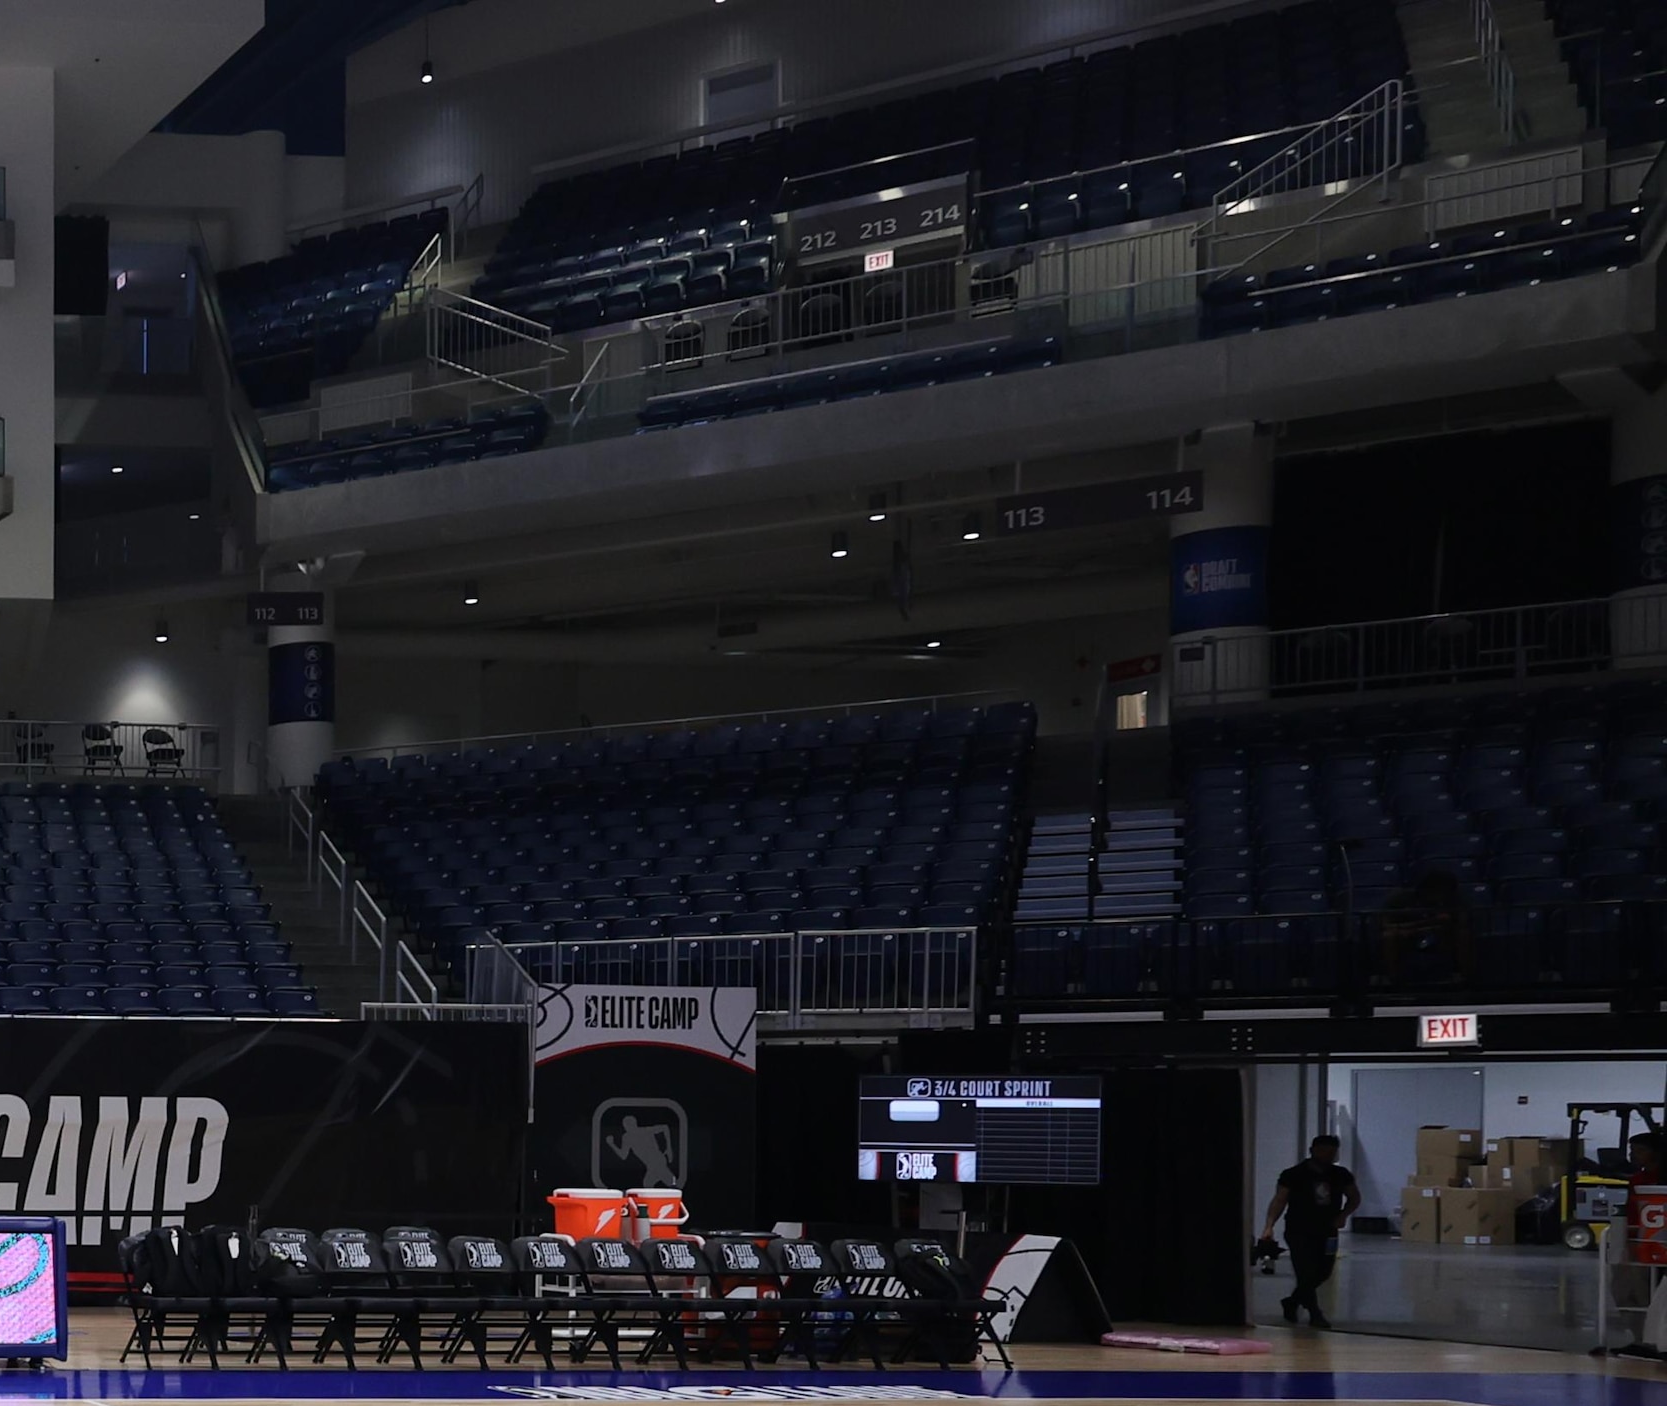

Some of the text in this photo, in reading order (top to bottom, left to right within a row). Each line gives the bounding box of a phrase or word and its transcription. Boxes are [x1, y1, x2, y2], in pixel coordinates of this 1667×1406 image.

[801, 204, 960, 252] 212 213 214
[868, 253, 891, 269] EXIT
[1004, 486, 1194, 529] 113 114
[254, 606, 319, 621] 112 113
[601, 995, 699, 1030] ELITE CAMP
[1427, 1017, 1470, 1040] EXIT
[934, 1080, 1052, 1097] 3/4 COURT SPRINT
[912, 1153, 935, 1166] ELITE
[911, 1166, 938, 1180] CAMP
[347, 1243, 365, 1255] ELITE
[413, 1243, 431, 1255] ELITE
[478, 1243, 497, 1255] ELITE
[542, 1243, 560, 1255] ELITE
[606, 1243, 624, 1255] ELITE
[670, 1244, 689, 1256] ELITE
[735, 1243, 754, 1256] ELITE
[797, 1244, 816, 1256] ELITE
[860, 1244, 880, 1257] ELITE
[416, 1255, 437, 1268] CAMP
[481, 1255, 503, 1268] CAMP
[544, 1254, 566, 1268] CAMP
[608, 1255, 631, 1268] CAMP
[673, 1255, 695, 1269] CAMP
[738, 1255, 760, 1269] CAMP
[800, 1256, 823, 1269] CAMP
[863, 1256, 885, 1269] CAMP
